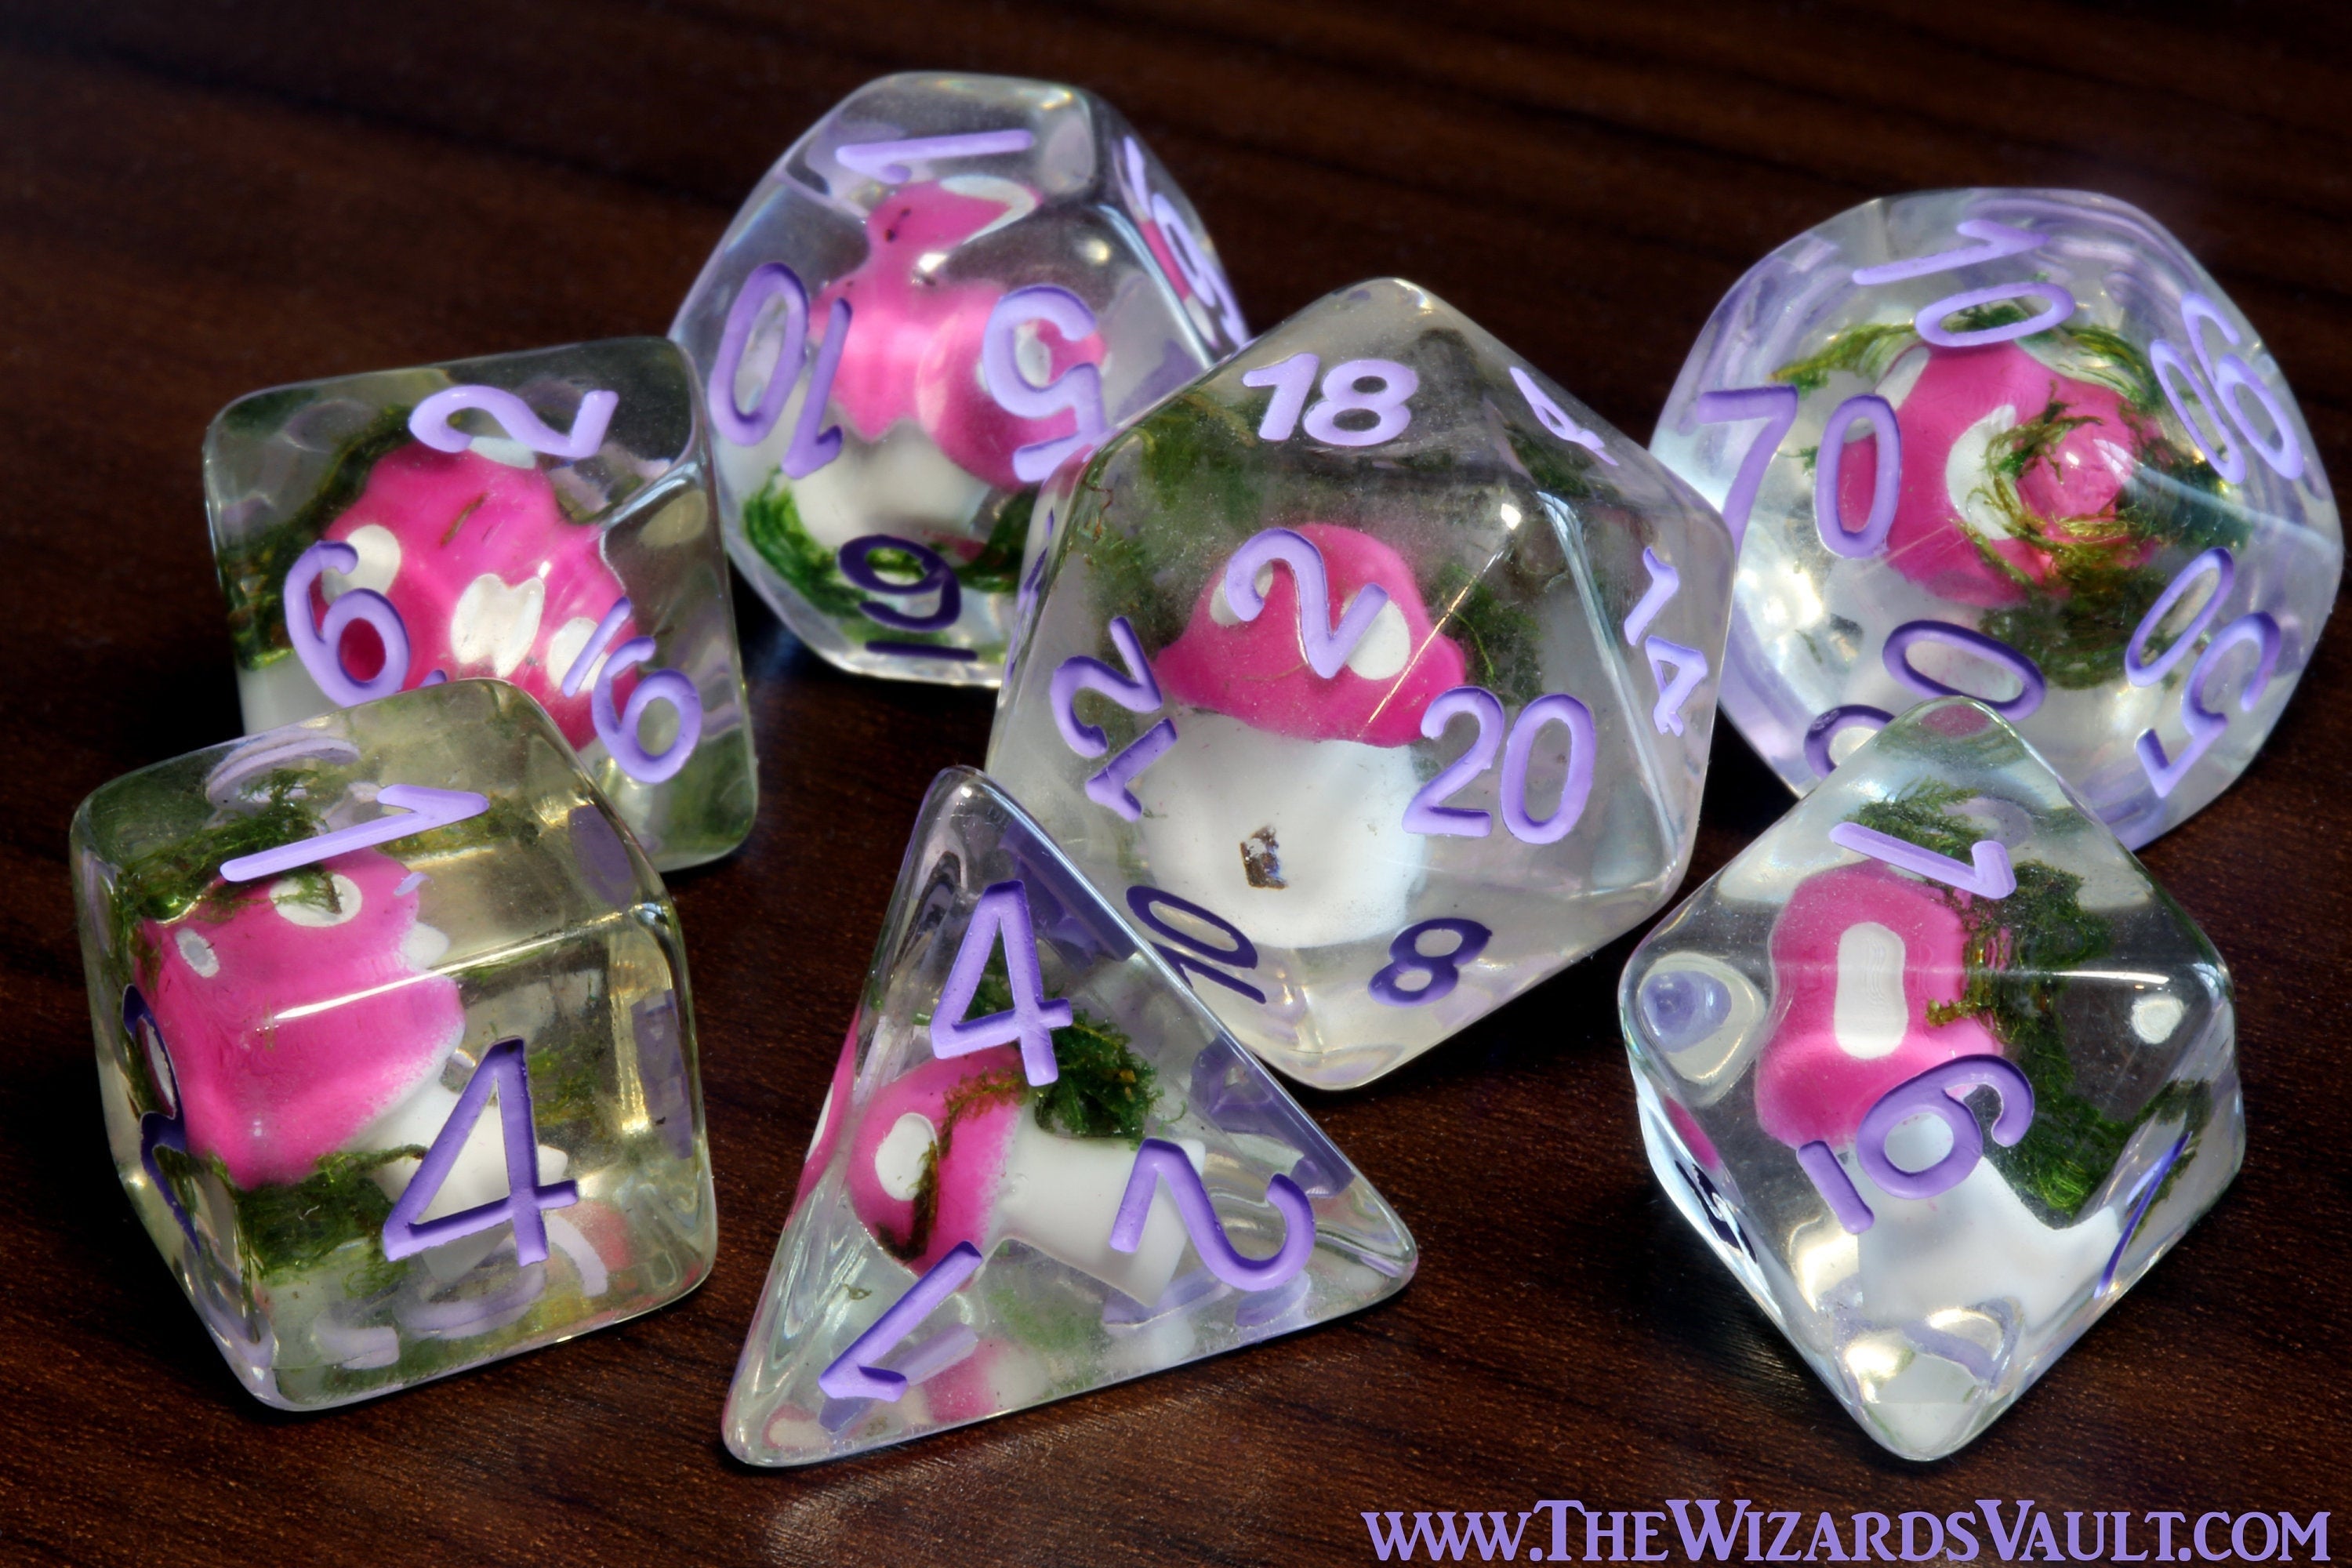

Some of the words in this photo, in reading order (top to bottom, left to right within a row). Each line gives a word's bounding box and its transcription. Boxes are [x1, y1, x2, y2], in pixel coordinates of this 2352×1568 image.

[1852, 220, 2077, 347] 10
[408, 384, 619, 459] 2
[708, 261, 852, 478] 10
[982, 283, 1113, 483] 5
[1242, 352, 1417, 448] 18
[1509, 367, 1619, 466] 4
[1697, 383, 1902, 561] 70
[1224, 527, 1388, 679] 2
[1624, 546, 1708, 737] 14
[2124, 546, 2281, 799] 50
[1051, 615, 1178, 823] 12
[1401, 685, 1596, 845] 20
[220, 784, 490, 882] 1
[1829, 821, 2017, 900] 1
[929, 879, 1073, 1087] 4
[1367, 916, 1493, 1007] 8
[382, 1036, 579, 1267] 4
[1109, 1138, 1317, 1293] 2
[818, 1240, 983, 1403] 1
